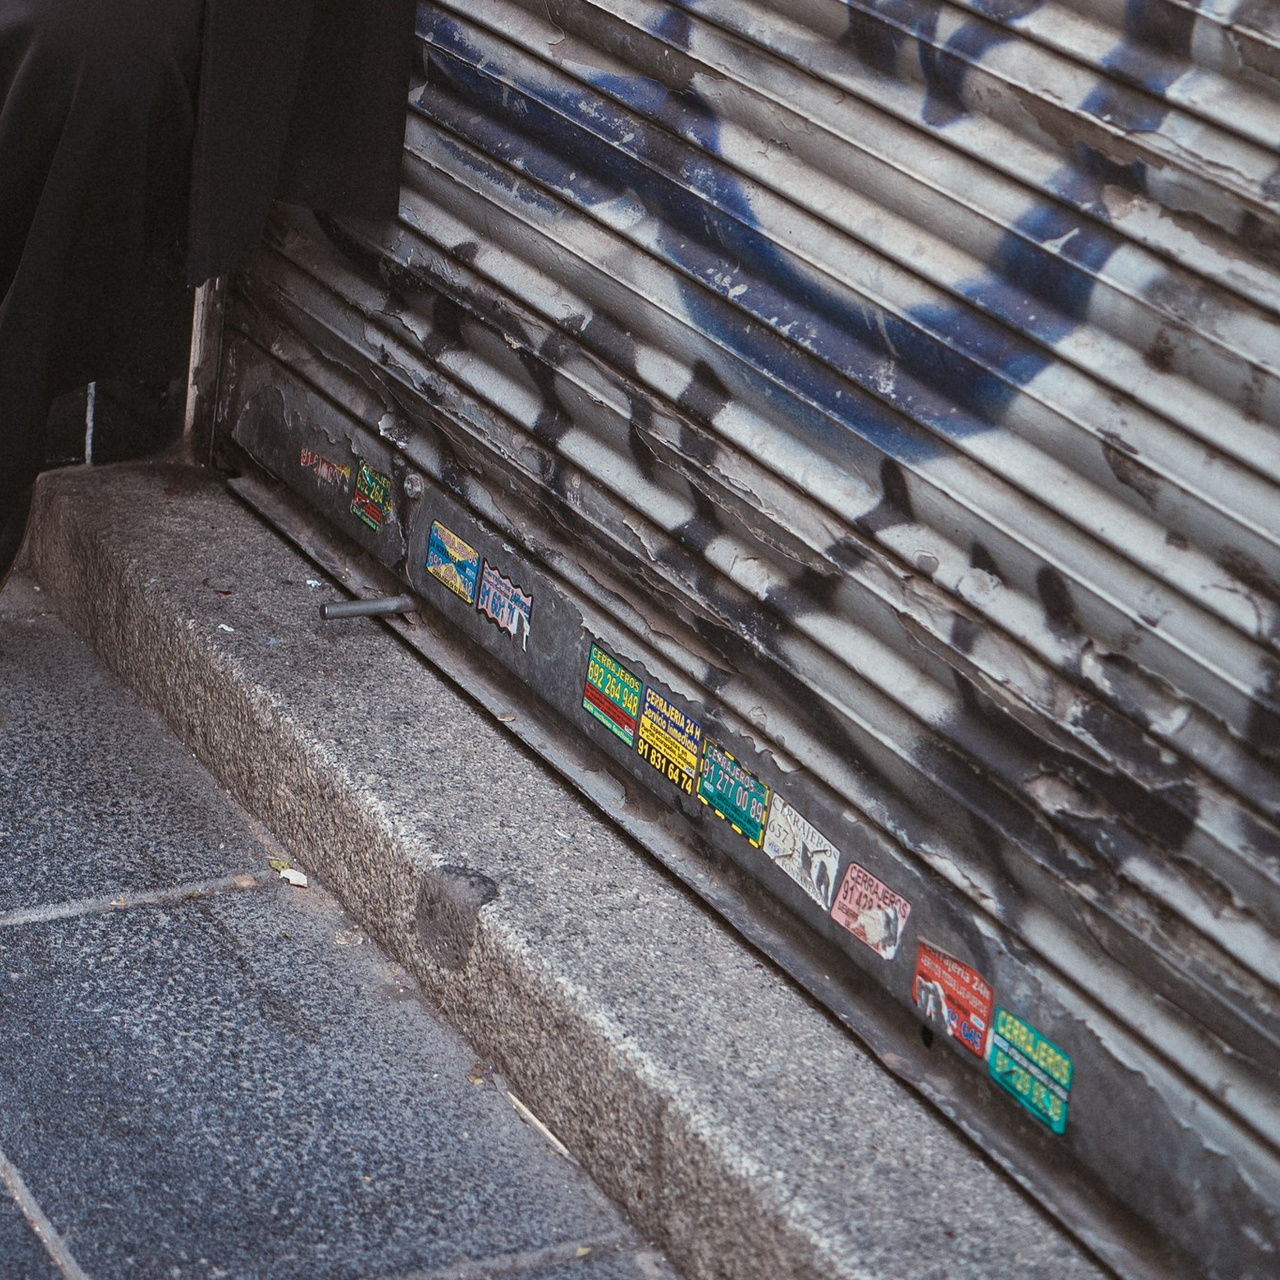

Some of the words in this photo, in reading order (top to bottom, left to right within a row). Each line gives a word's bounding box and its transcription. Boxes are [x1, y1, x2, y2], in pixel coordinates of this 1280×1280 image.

[370, 482, 384, 503] 264
[432, 524, 478, 567] CERRAJEROS
[480, 581, 490, 609] 91
[587, 658, 604, 689] 692
[604, 672, 621, 703] 264
[621, 686, 638, 717] 948
[591, 646, 639, 693] CERRAJEROS
[643, 701, 667, 730] Servicio
[645, 687, 685, 729] CERRAJERIA
[685, 718, 694, 736] 24
[694, 725, 700, 741] H
[649, 722, 680, 752] Especialistas
[638, 740, 649, 759] 91
[650, 751, 666, 773] 831
[668, 763, 680, 784] 64
[682, 774, 693, 794] 74
[706, 744, 755, 793] CERRAJEROS
[702, 756, 714, 784] 91
[716, 768, 734, 800] 277
[735, 784, 749, 812] 00
[749, 796, 763, 824] 89
[768, 841, 780, 855] VISA
[769, 817, 788, 844] 637
[772, 796, 838, 860] CERRAJEROS
[842, 881, 854, 904] 91
[850, 865, 908, 918] CERRAJEROS
[972, 976, 990, 999] 24h
[998, 1010, 1069, 1084] CERRAJEROS
